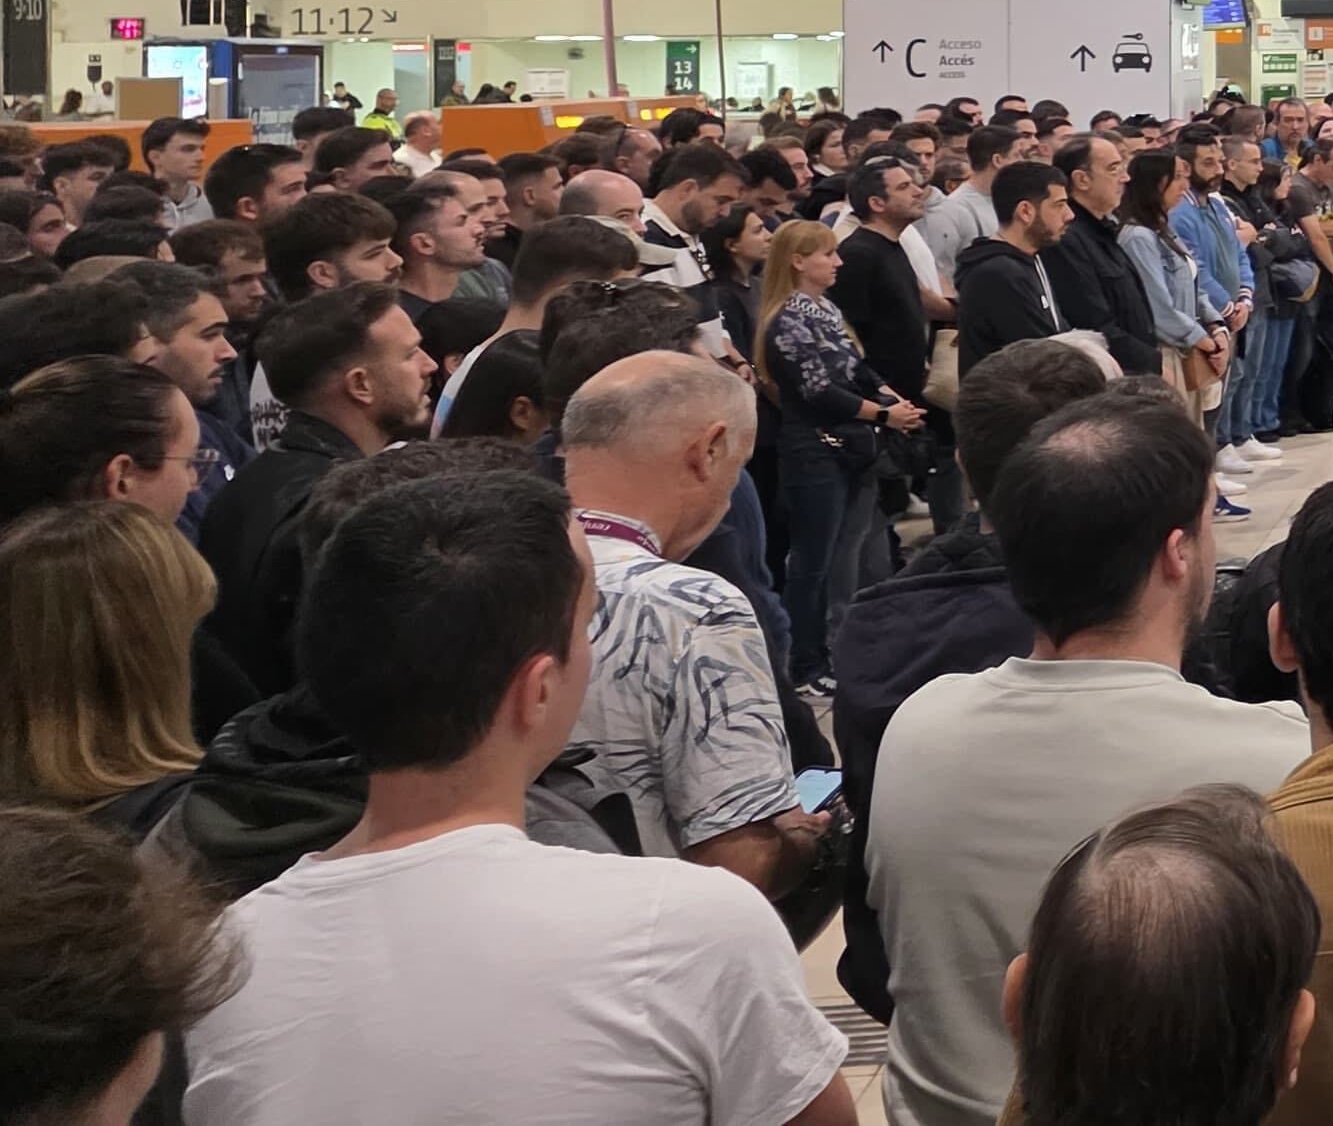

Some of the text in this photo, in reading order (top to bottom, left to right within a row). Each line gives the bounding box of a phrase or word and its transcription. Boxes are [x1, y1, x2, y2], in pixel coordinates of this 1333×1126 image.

[938, 38, 982, 51] Acceso
[905, 38, 927, 78] C
[938, 53, 975, 66] Accés
[674, 60, 692, 74] 13
[674, 76, 694, 91] 14
